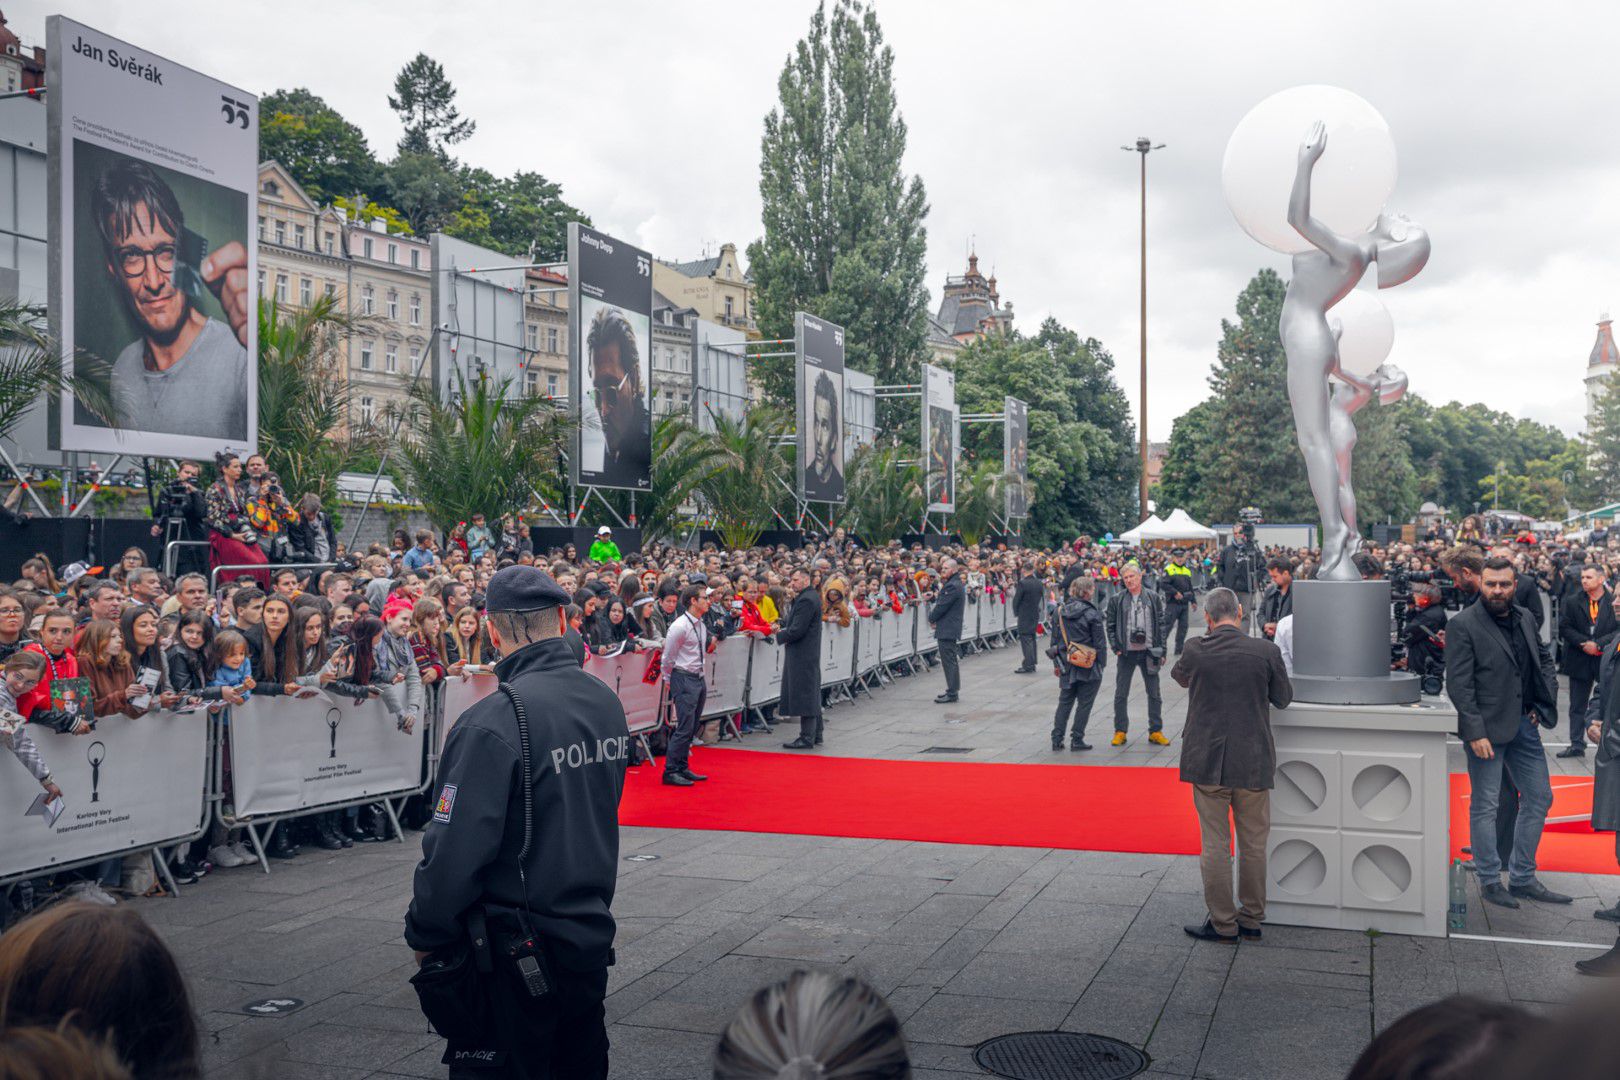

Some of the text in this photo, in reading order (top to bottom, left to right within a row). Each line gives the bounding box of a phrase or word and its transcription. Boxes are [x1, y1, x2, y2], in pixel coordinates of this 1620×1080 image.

[72, 36, 163, 86] Jan Svěrák
[581, 232, 600, 250] Johnny
[551, 736, 630, 775] POLICIE
[56, 814, 130, 834] International Film Festival
[76, 811, 98, 820] Karlovy
[455, 1050, 497, 1061] POICIE
